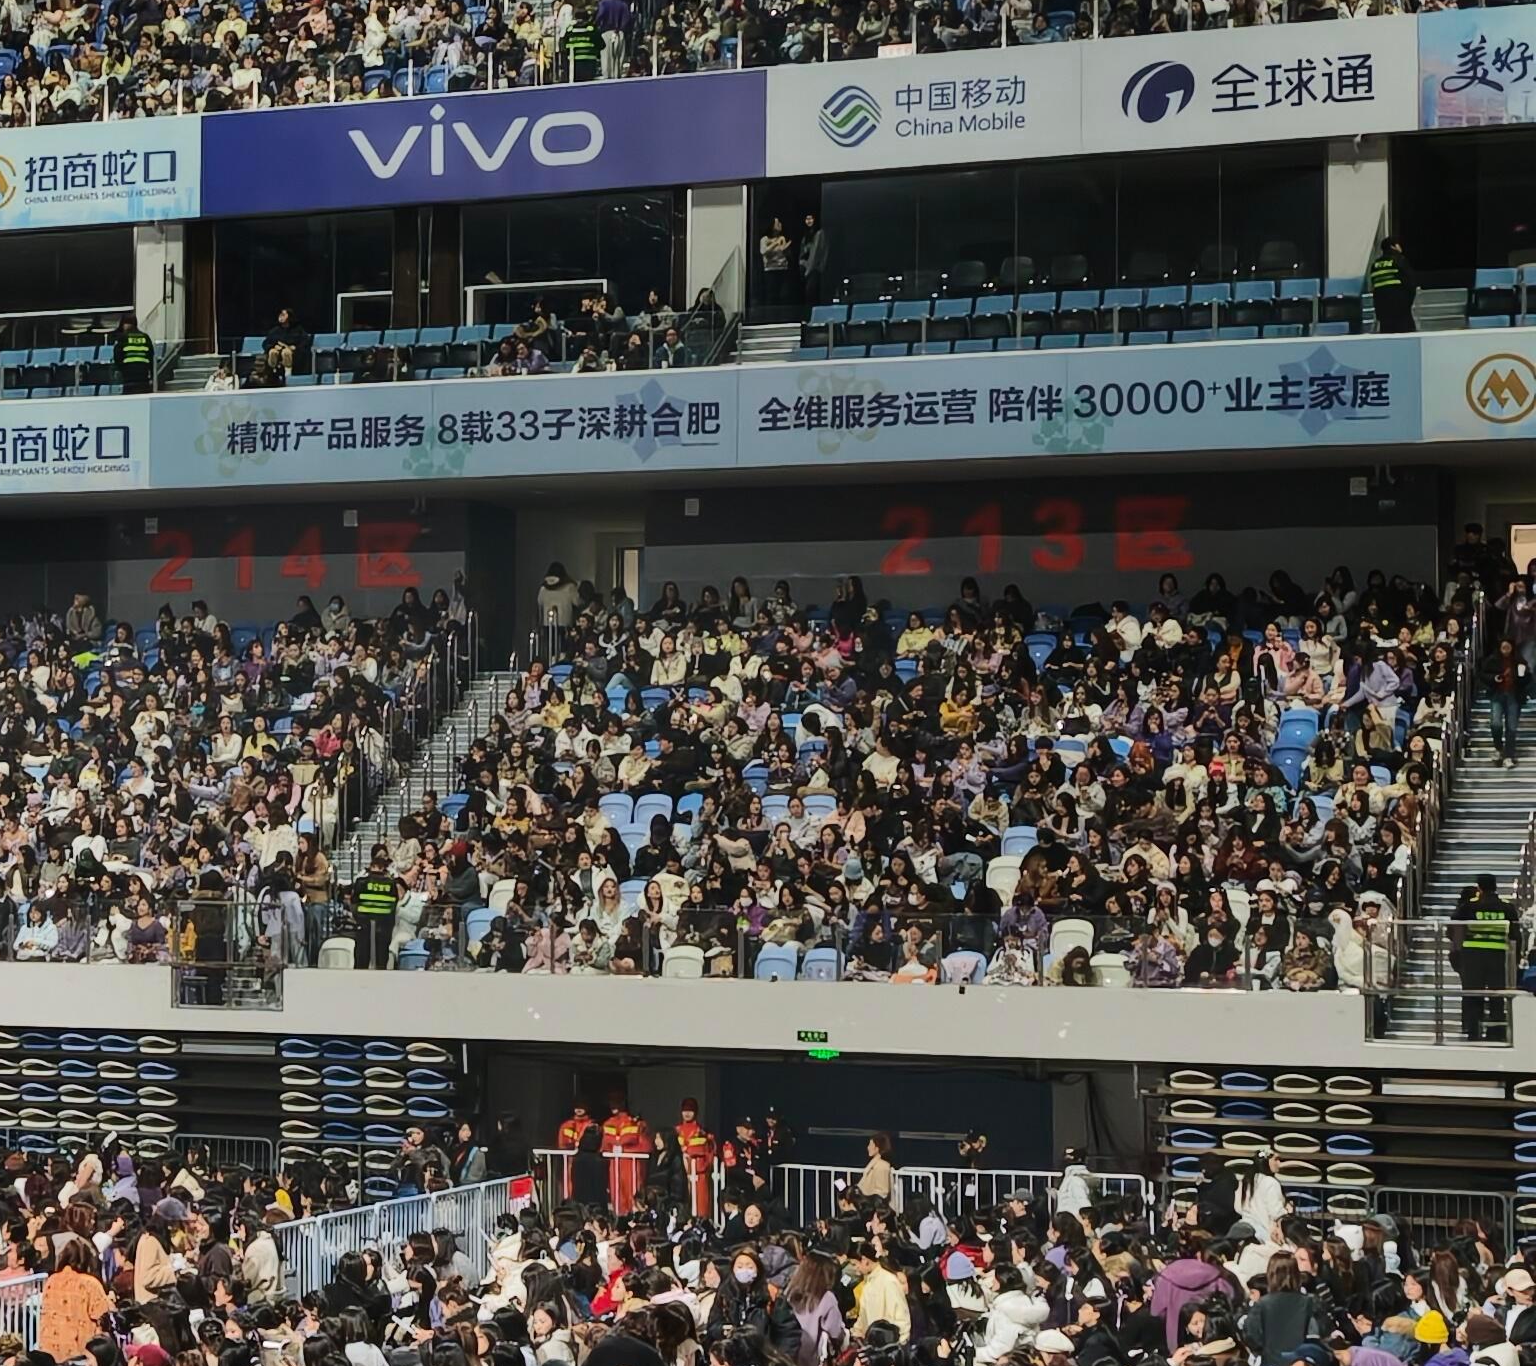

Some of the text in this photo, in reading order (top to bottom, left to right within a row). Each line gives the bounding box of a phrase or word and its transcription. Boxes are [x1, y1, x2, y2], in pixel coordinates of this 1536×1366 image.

[1211, 53, 1375, 115] 全球通
[1441, 34, 1536, 93] 美好
[895, 75, 1026, 115] 中国移动
[348, 103, 605, 179] vivo
[895, 111, 1026, 137] China Mobile
[24, 149, 177, 193] 招商蛇口
[226, 401, 721, 456] 精研产品服务 8载33子深耕合肥
[757, 388, 978, 434] 全维服务运营
[989, 385, 1064, 424] 陪伴
[149, 522, 423, 593] 214区
[880, 495, 1194, 575] 213区
